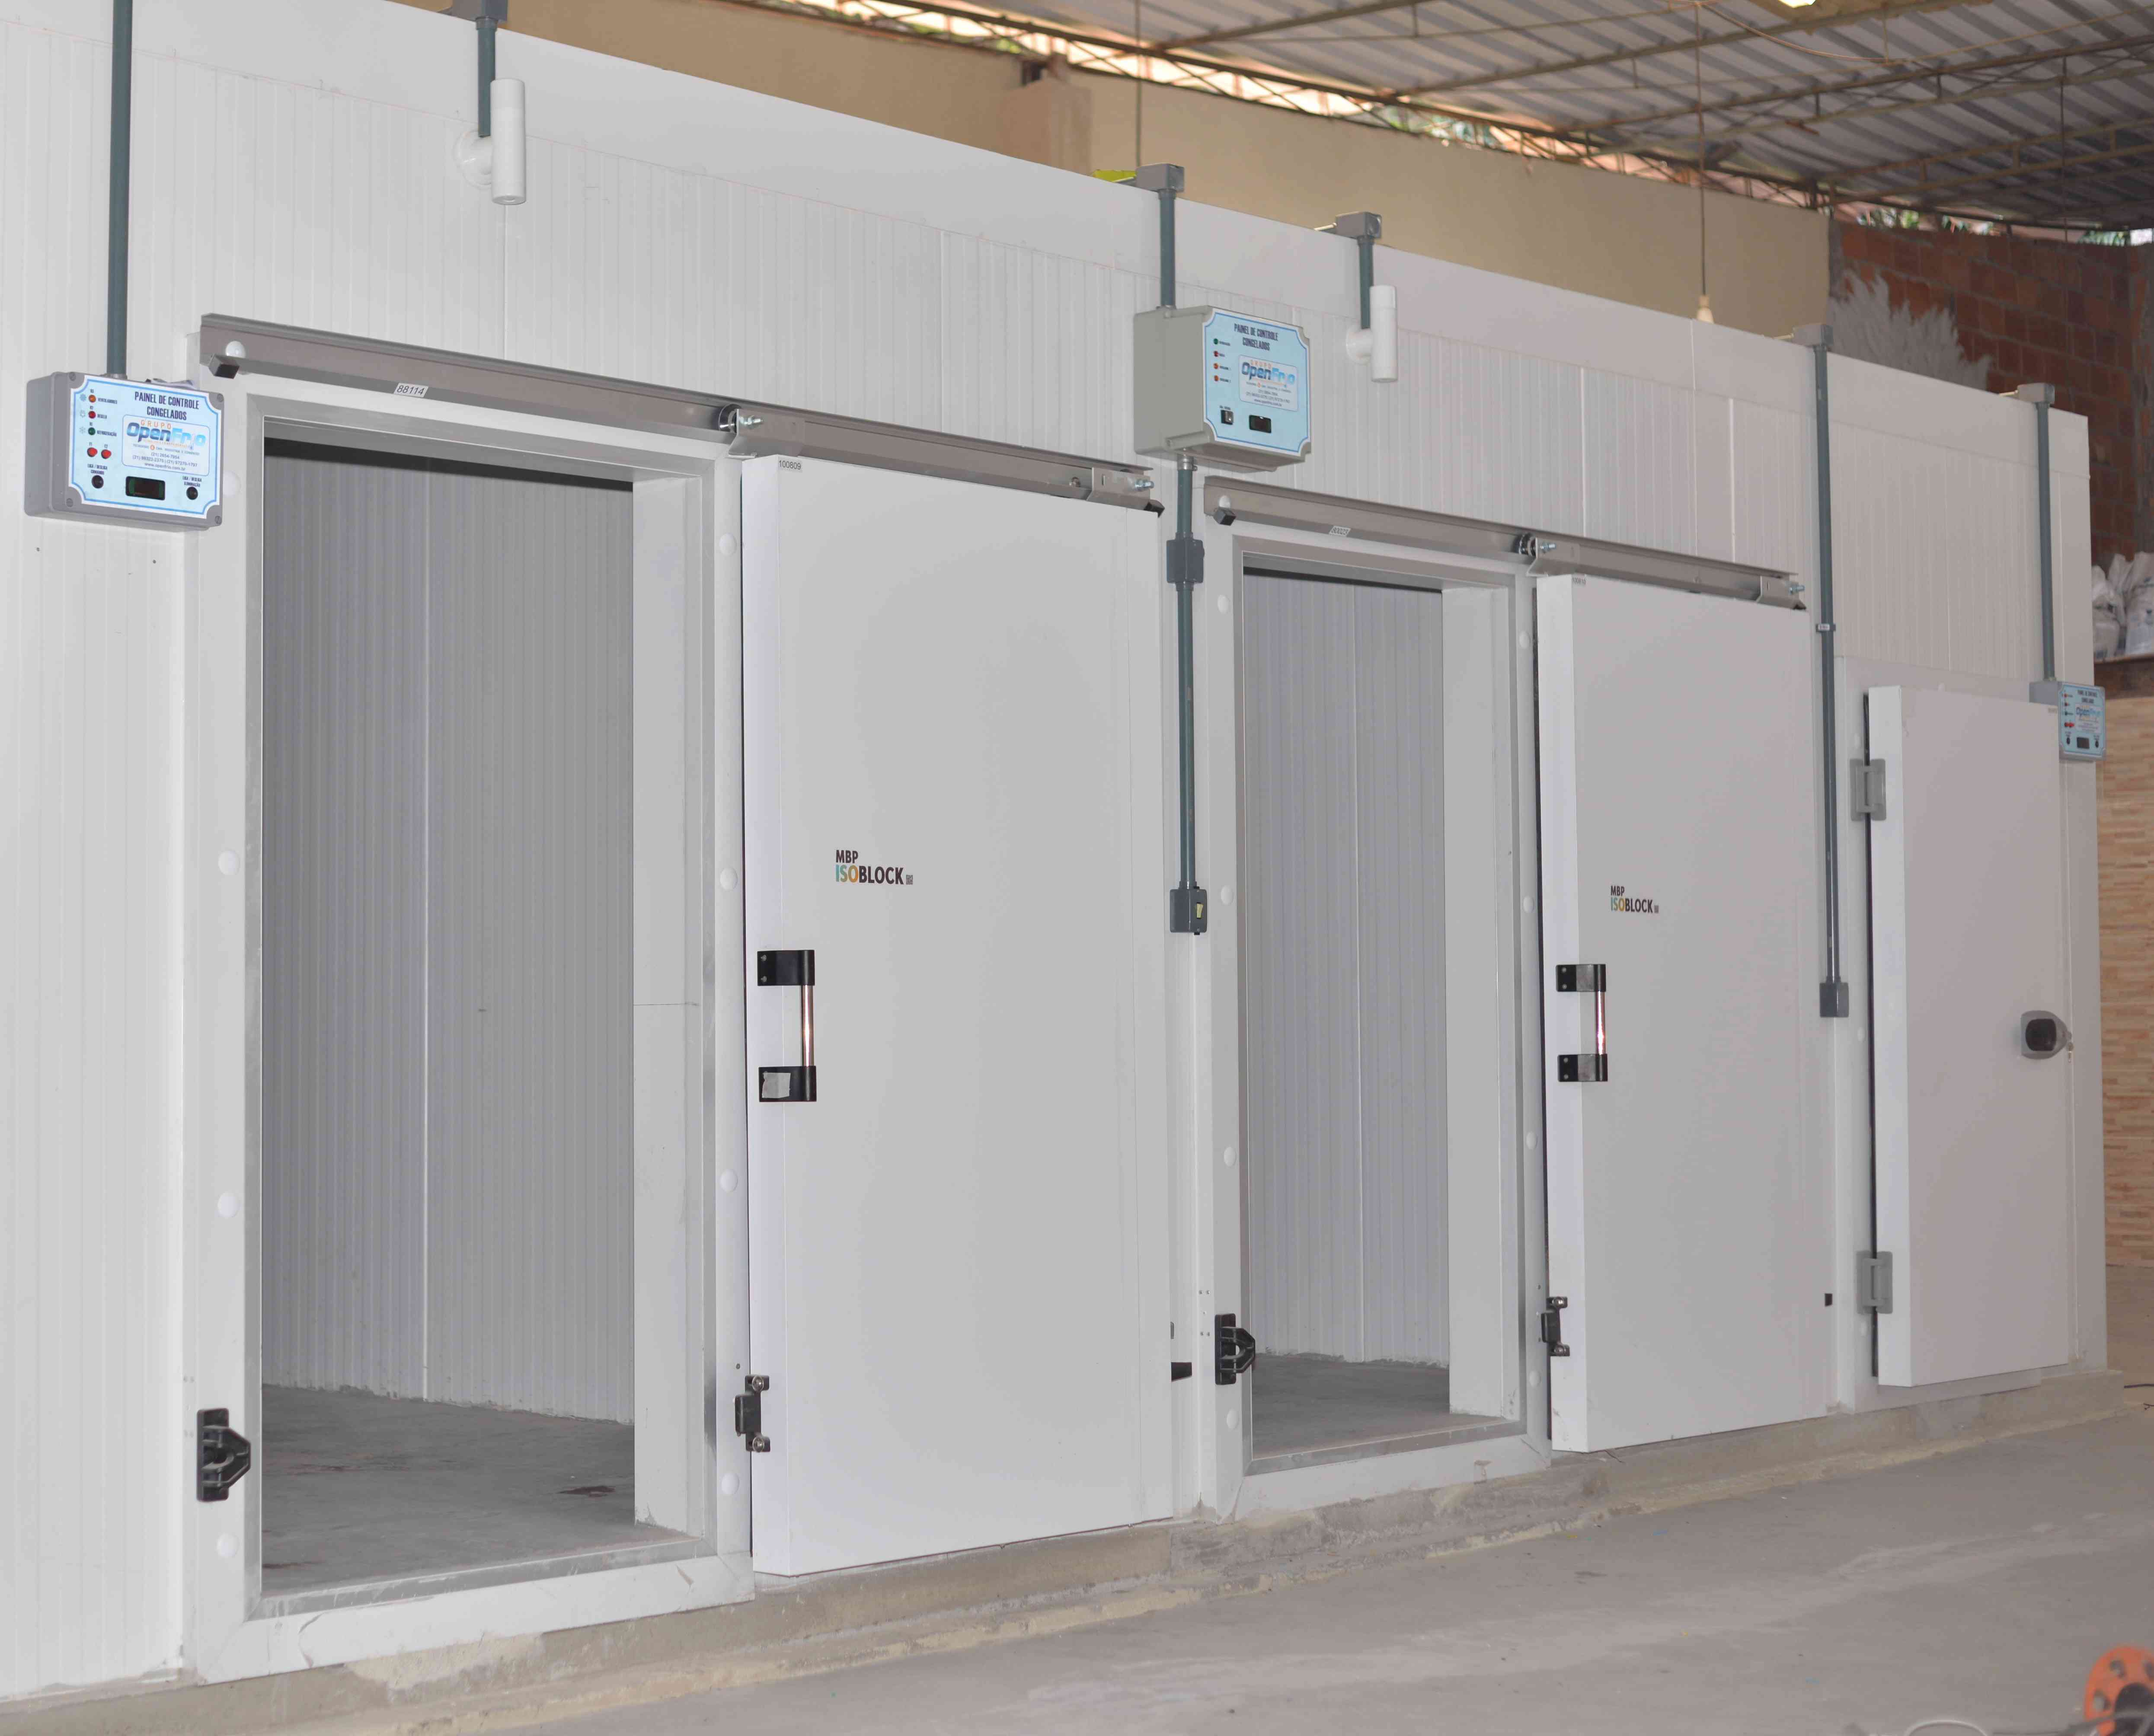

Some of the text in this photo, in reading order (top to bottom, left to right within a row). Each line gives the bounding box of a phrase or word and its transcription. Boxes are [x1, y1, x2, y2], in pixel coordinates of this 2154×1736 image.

[1234, 323, 1250, 335] PAINEL
[397, 385, 425, 395] 88114
[135, 391, 199, 409] PAINEL DE CONTROLE
[147, 406, 187, 420] CONGELADOS
[141, 419, 172, 429] GRUPO
[779, 460, 801, 470] 100809
[836, 850, 859, 863] MBP
[836, 864, 904, 885] ISOBLOCK
[1611, 885, 1625, 896] MBP
[1611, 897, 1653, 913] ISOBLOCK
